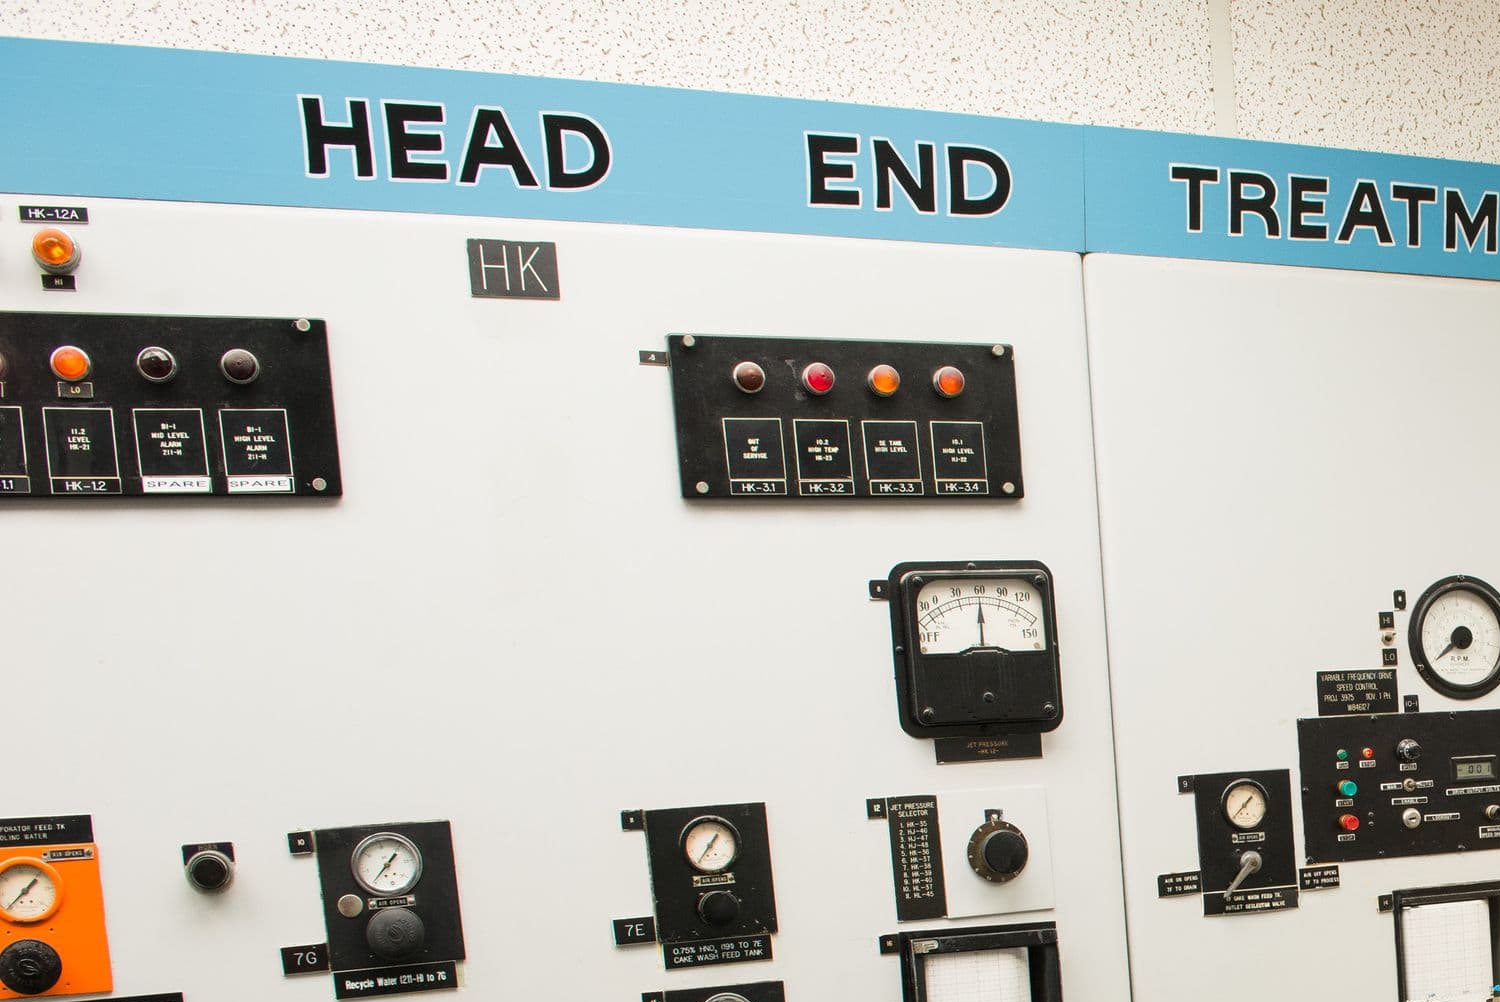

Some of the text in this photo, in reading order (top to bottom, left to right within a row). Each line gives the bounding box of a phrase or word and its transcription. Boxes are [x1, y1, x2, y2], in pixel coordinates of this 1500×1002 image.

[297, 93, 613, 192] HEAD
[803, 130, 1012, 218] END
[479, 244, 549, 292] HK
[230, 480, 288, 488] SPARE
[950, 586, 961, 597] 30
[974, 584, 985, 595] 60
[997, 586, 1008, 598] 90
[932, 595, 939, 605] 0
[1015, 591, 1031, 602] 120
[920, 632, 940, 643] OFF
[1022, 628, 1038, 639] 150
[1320, 671, 1393, 682] VARIABLE FREQUENCY DRIVE
[1336, 682, 1378, 692] SPEED CONTROL
[904, 802, 935, 810] PRESSURE
[898, 809, 928, 817] SELECTOR
[24, 832, 48, 840] WATER
[625, 924, 645, 937] 7E
[672, 939, 763, 955] 0.75% TO 7E
[294, 951, 317, 965] 7G
[673, 949, 763, 964] CAKE WASH FEED TANK
[345, 979, 374, 991] Recycle
[376, 977, 397, 987] Water
[426, 974, 435, 982] to
[436, 971, 447, 980] 7G
